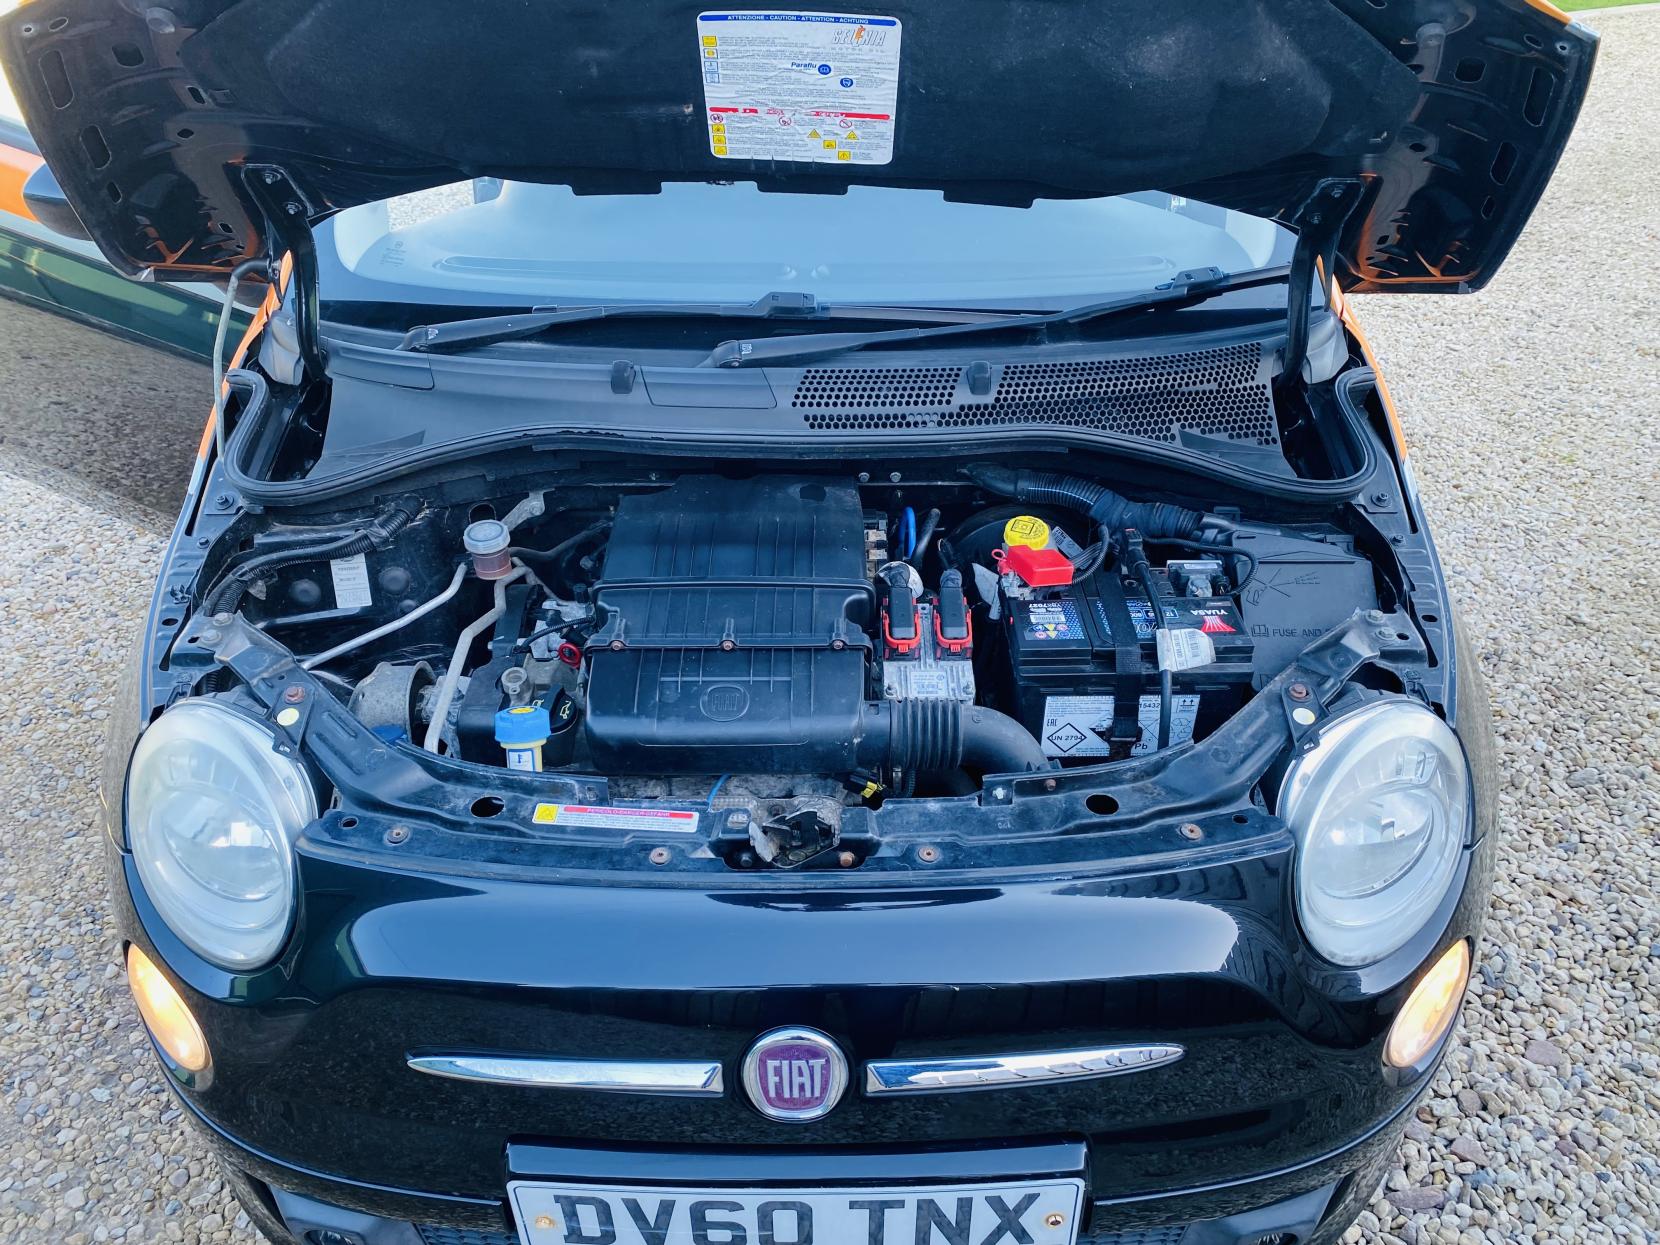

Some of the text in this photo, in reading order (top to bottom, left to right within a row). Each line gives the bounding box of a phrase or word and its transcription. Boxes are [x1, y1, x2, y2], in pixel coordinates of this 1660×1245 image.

[791, 61, 817, 69] Paraflu
[1272, 628, 1297, 637] FUSE
[1302, 628, 1321, 637] AND
[766, 1057, 827, 1099] FIAT
[553, 1192, 1041, 1245] DV60 TNX
